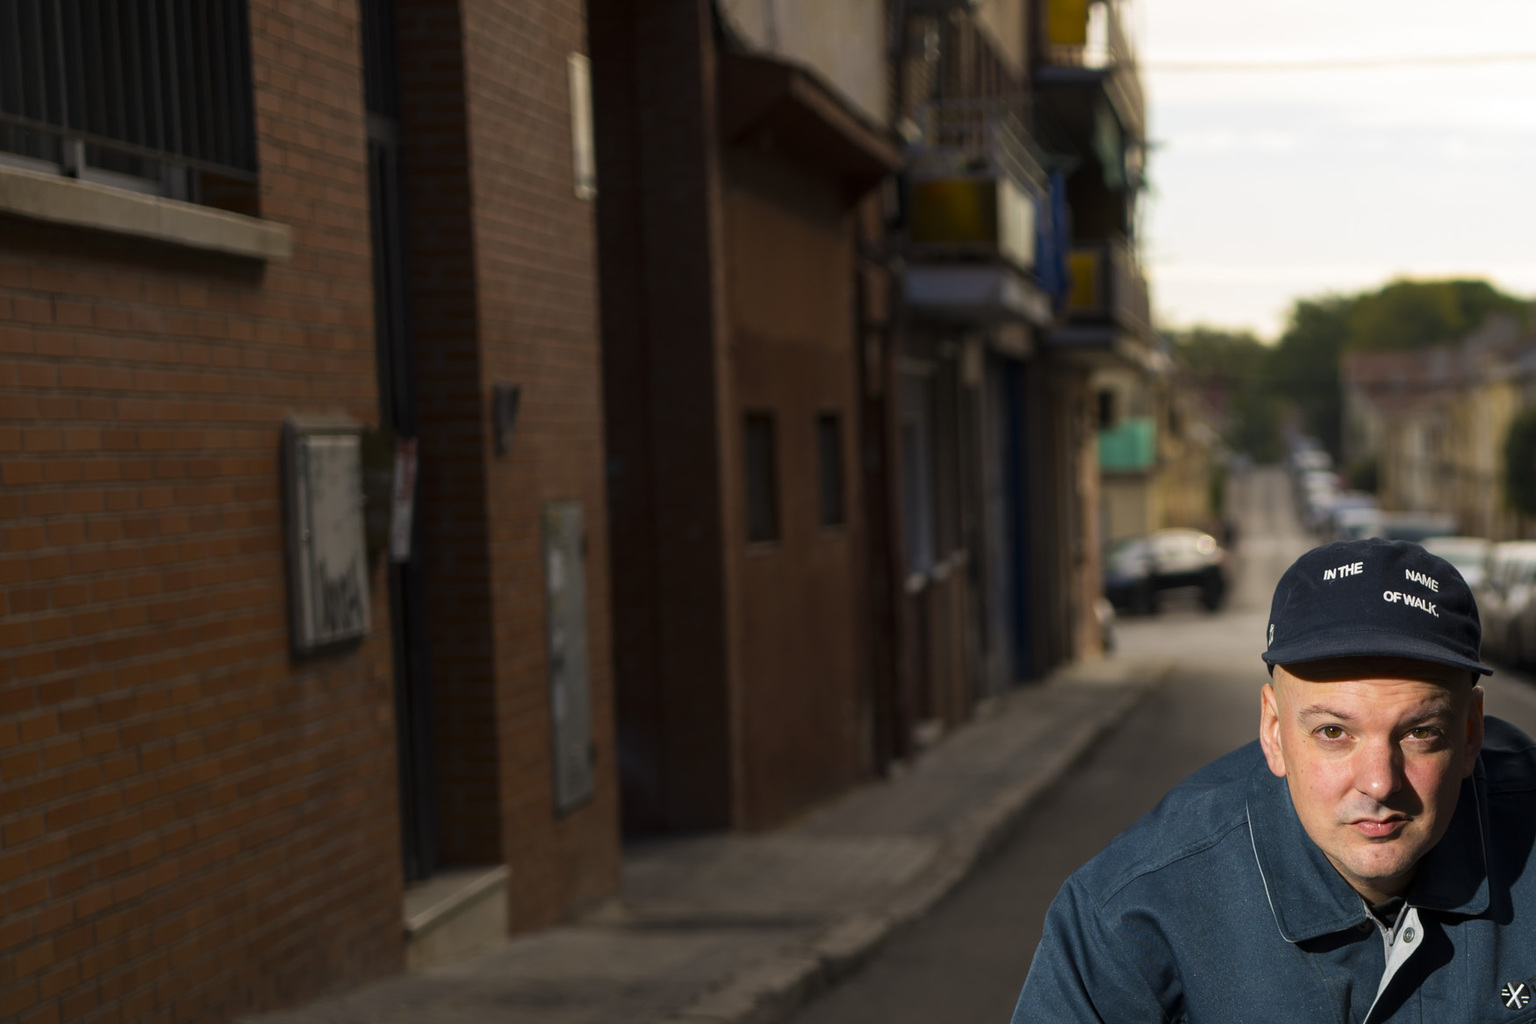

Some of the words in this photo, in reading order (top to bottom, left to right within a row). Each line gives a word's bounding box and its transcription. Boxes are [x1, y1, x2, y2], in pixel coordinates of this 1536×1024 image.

[1323, 568, 1337, 580] IN
[1337, 561, 1364, 578] THE
[1405, 568, 1439, 593] NAME
[1383, 590, 1402, 603] OF
[1402, 593, 1439, 618] WALK.
